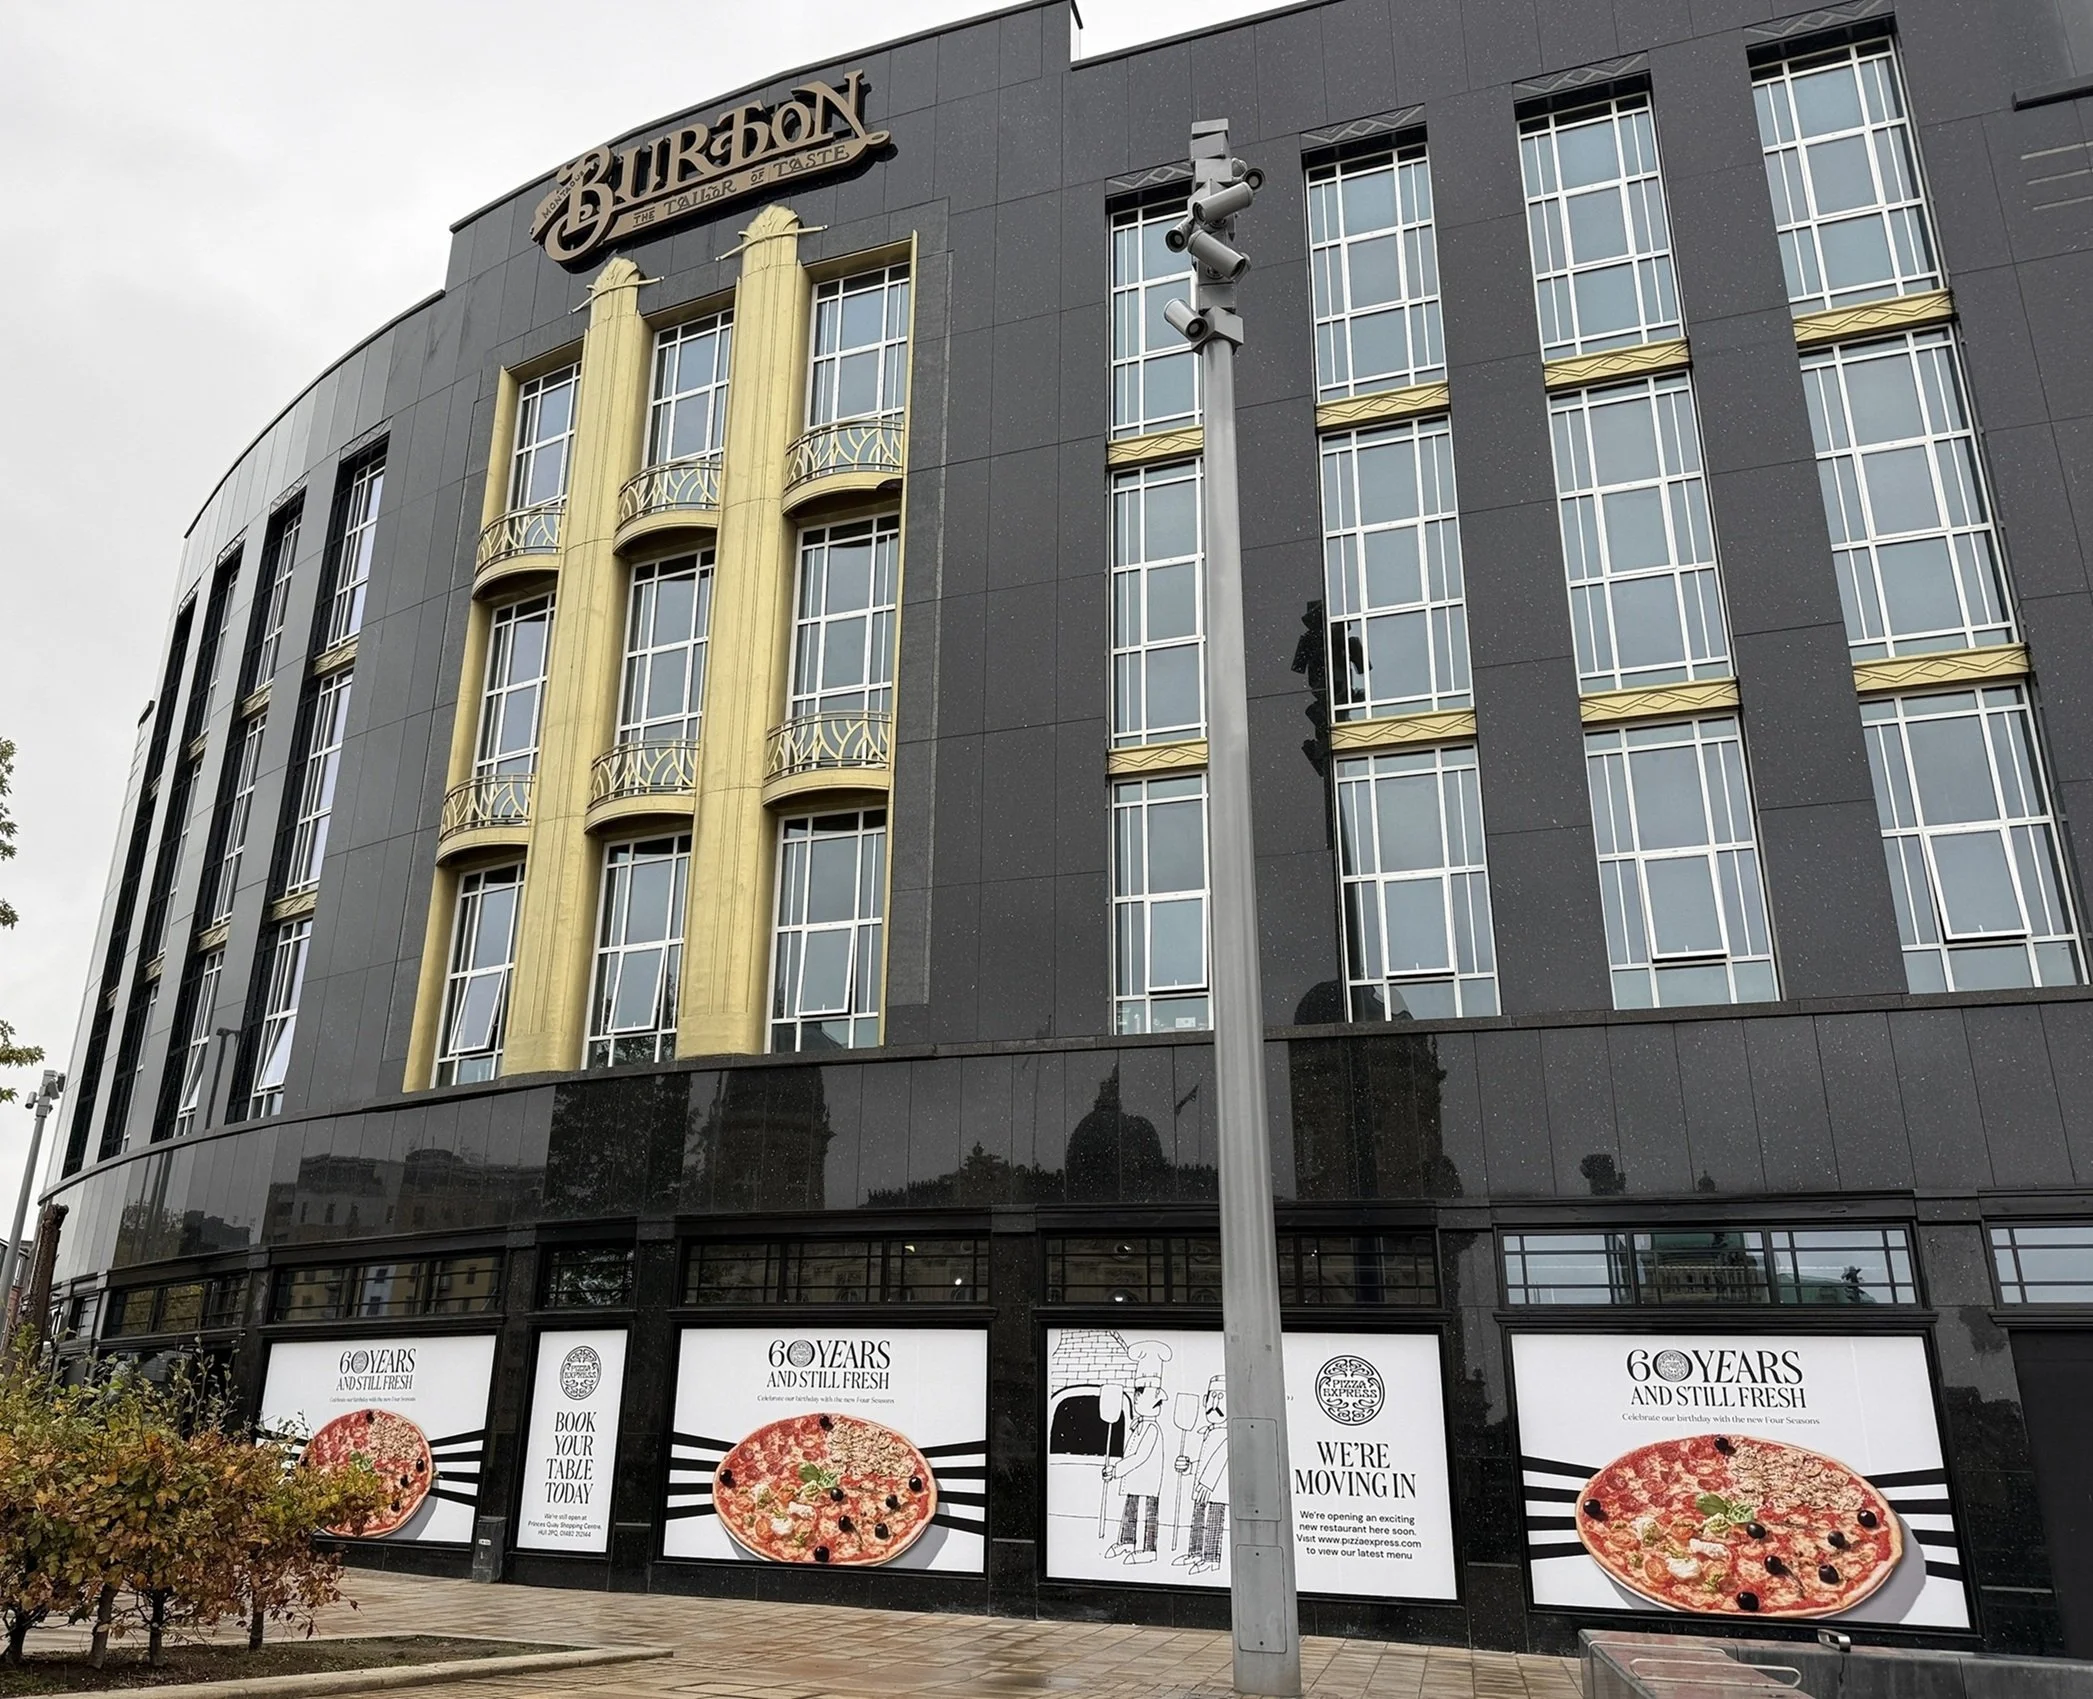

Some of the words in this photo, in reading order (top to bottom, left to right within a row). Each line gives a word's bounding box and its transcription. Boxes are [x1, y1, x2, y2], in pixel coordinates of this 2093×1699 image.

[545, 69, 890, 262] BURTON
[633, 209, 655, 224] THE
[664, 180, 737, 216] TAILOR
[750, 170, 764, 183] OF
[773, 145, 849, 178] TASTE
[370, 1348, 416, 1373] YEARS
[816, 1339, 891, 1369] YEARS
[565, 1371, 597, 1379] EXPRESS
[1692, 1349, 1803, 1385] YEARS
[336, 1375, 356, 1391] AND
[356, 1375, 382, 1391] STILL
[383, 1374, 413, 1391] FRESH
[766, 1370, 797, 1388] AND
[799, 1370, 840, 1389] STILL
[843, 1371, 889, 1390] FRESH
[1332, 1379, 1367, 1389] PIZZA
[1323, 1388, 1378, 1398] EXPRESS
[1631, 1385, 1673, 1406] AND
[1676, 1386, 1735, 1407] STILL
[1738, 1386, 1807, 1408] FRESH
[555, 1411, 597, 1433] BOOK
[1622, 1413, 1660, 1421] Celebrate
[1677, 1413, 1711, 1424] birthday
[1712, 1415, 1731, 1423] with
[1732, 1415, 1746, 1423] the
[1764, 1416, 1784, 1424] Four
[1785, 1416, 1820, 1425] Seasons
[555, 1435, 594, 1456] YOUR
[1316, 1441, 1391, 1469] WE'RE
[546, 1458, 594, 1480] TABLE
[545, 1482, 594, 1504] TODAY
[1294, 1468, 1388, 1498] MOVING
[1393, 1473, 1416, 1499] IN
[560, 1522, 583, 1530] Shopping
[1300, 1510, 1326, 1520] We're
[1327, 1512, 1364, 1524] opening
[1379, 1514, 1415, 1526] exciting
[1299, 1523, 1317, 1531] new
[1320, 1523, 1367, 1533] restaurant
[1369, 1525, 1390, 1535] here
[1392, 1528, 1417, 1536] soon.
[1296, 1533, 1316, 1543] Visit
[1318, 1535, 1422, 1548] www.pizzaexpress.com
[1306, 1547, 1316, 1555] to
[1318, 1547, 1338, 1556] view
[1341, 1549, 1356, 1557] our
[1358, 1548, 1384, 1558] latest
[1386, 1551, 1413, 1560] menu
